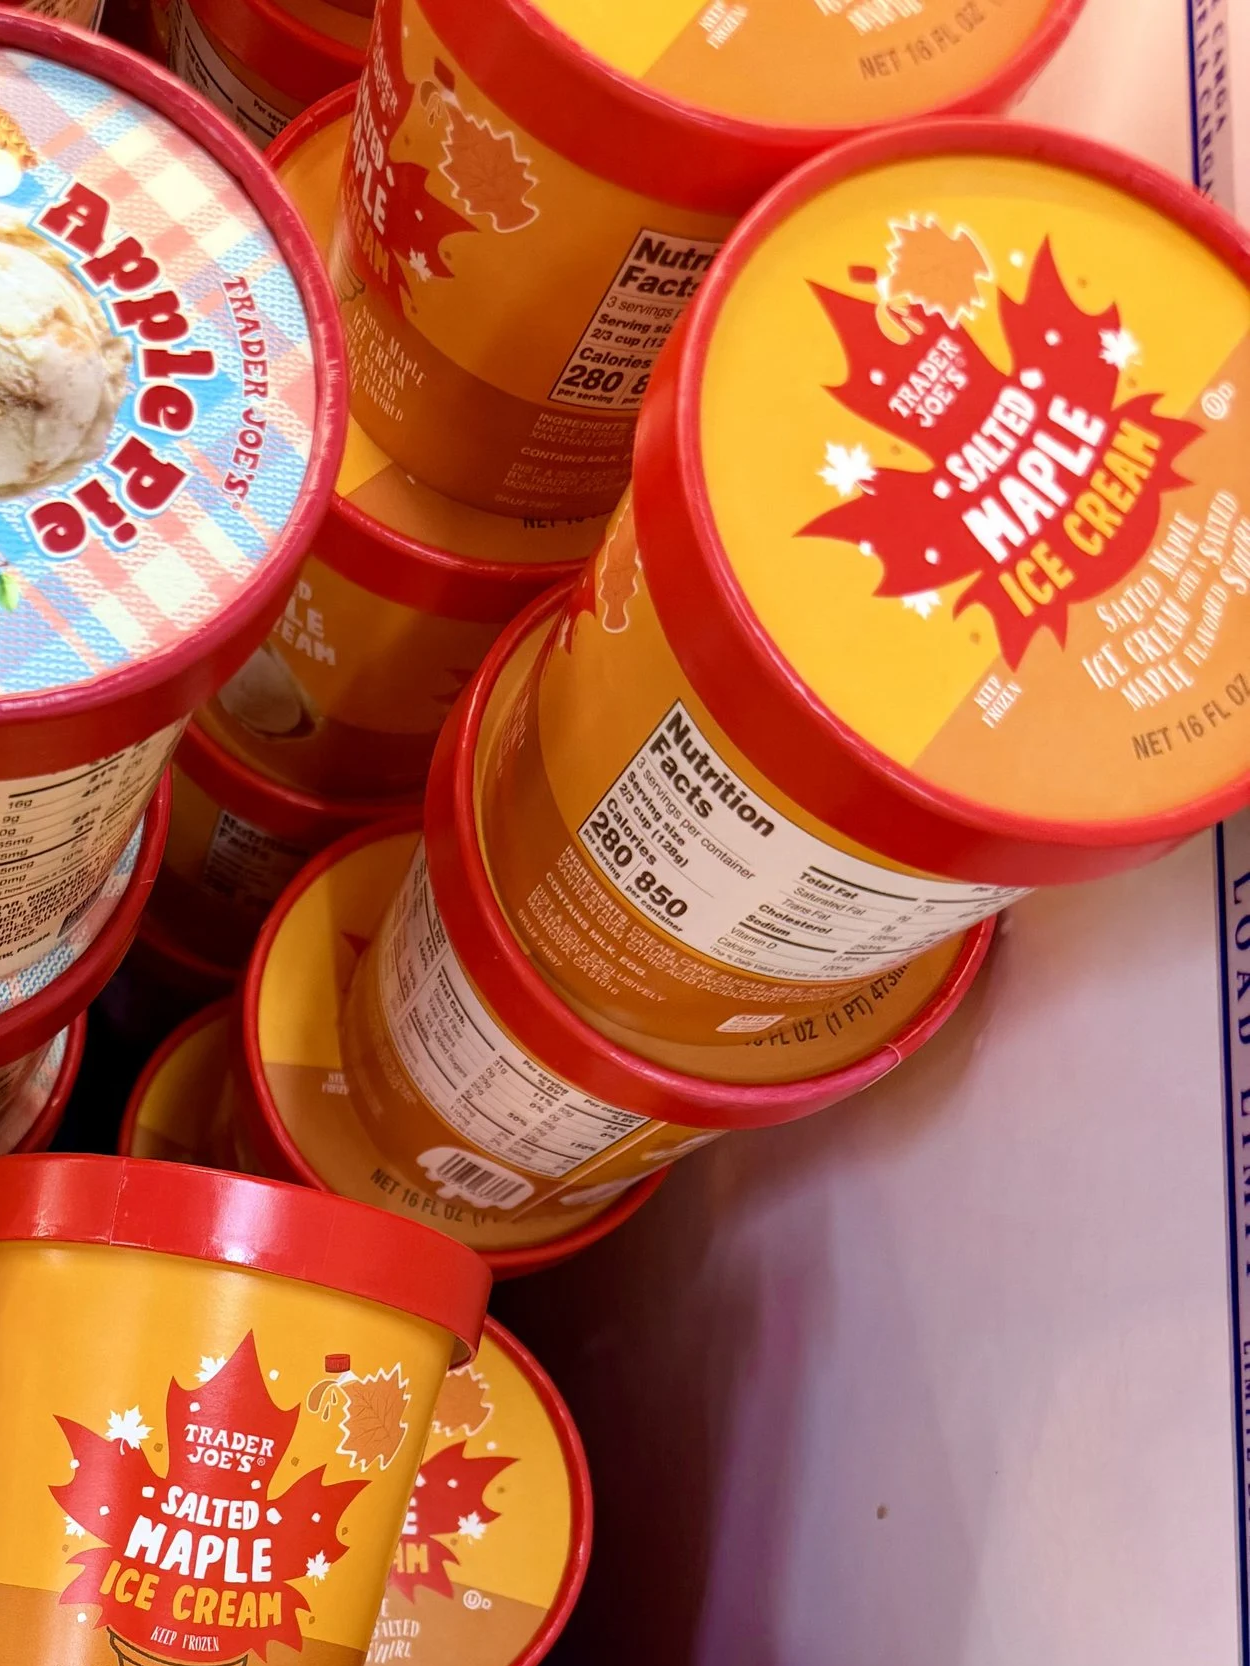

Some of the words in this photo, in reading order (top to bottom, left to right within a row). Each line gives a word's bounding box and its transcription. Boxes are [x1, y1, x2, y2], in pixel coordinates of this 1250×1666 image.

[40, 182, 214, 431] Apple
[224, 277, 268, 399] TRADER
[888, 336, 963, 419] TRADER
[945, 386, 1037, 493] SALTED
[961, 396, 1107, 564] MAPLE
[30, 435, 190, 554] Pie
[998, 540, 1077, 617] ICE
[1063, 419, 1162, 558] CREAM
[648, 733, 715, 819] Facts
[664, 710, 778, 838] Nutrition
[590, 812, 634, 868] 280
[635, 870, 688, 920] 850
[606, 798, 658, 867] Calories
[699, 828, 755, 881] container
[184, 1423, 274, 1457] TRADER
[123, 1515, 273, 1583] MAPLE
[161, 1486, 259, 1530] SALTED
[99, 1560, 160, 1611] ICE
[172, 1585, 282, 1628] CREAM
[150, 1625, 178, 1646] KEEP
[183, 1633, 220, 1652] FROZEN
